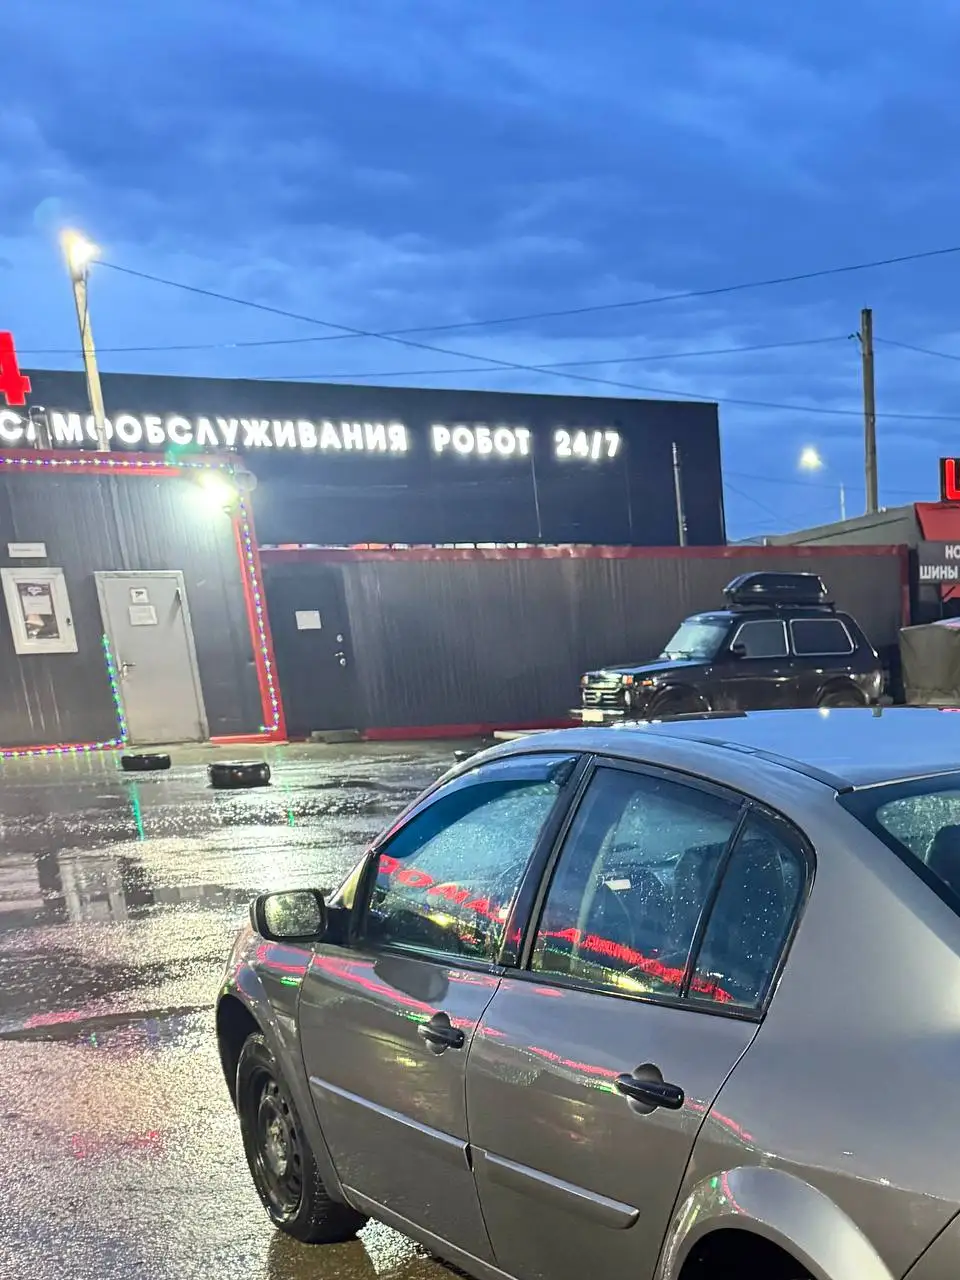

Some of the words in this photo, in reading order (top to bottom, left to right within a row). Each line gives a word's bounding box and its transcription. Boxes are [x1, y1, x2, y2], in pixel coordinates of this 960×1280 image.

[432, 424, 530, 455] РОБОТ
[555, 430, 620, 459] 24/7
[920, 565, 958, 579] ШИНЫ
